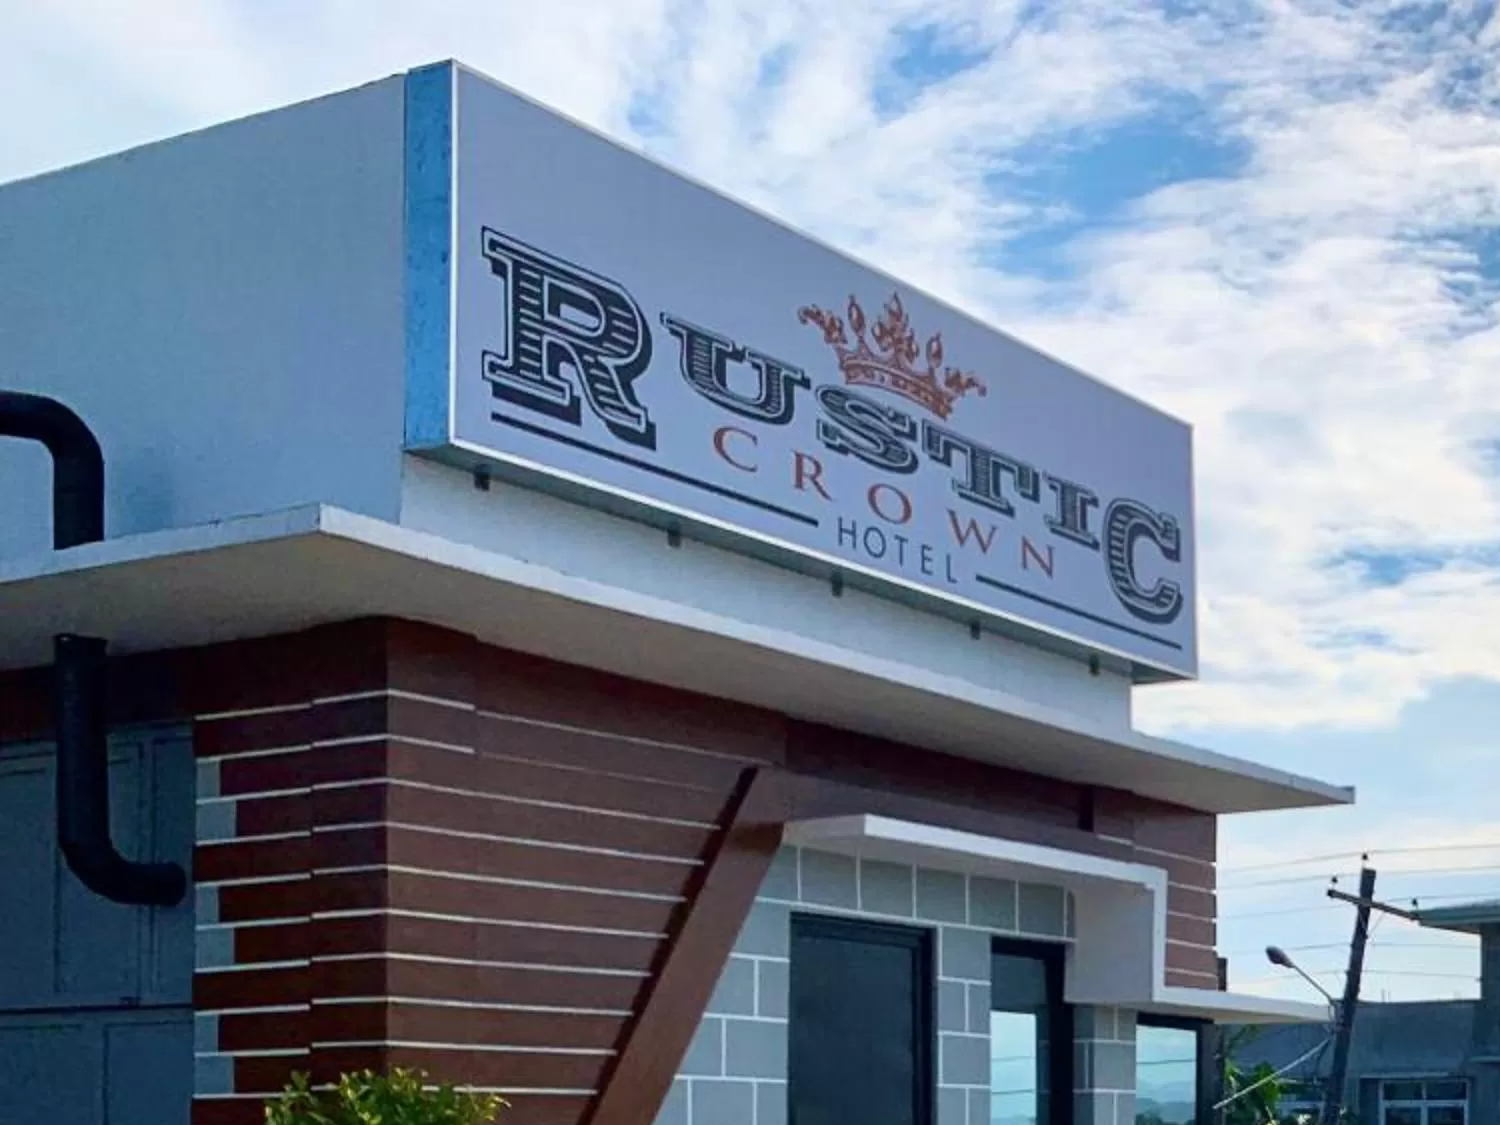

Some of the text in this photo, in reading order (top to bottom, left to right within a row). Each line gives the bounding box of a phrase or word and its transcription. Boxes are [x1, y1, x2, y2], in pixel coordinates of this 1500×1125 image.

[482, 226, 1183, 624] RUSTIC
[713, 427, 1054, 578] CROWN
[838, 517, 956, 582] HOTEL
